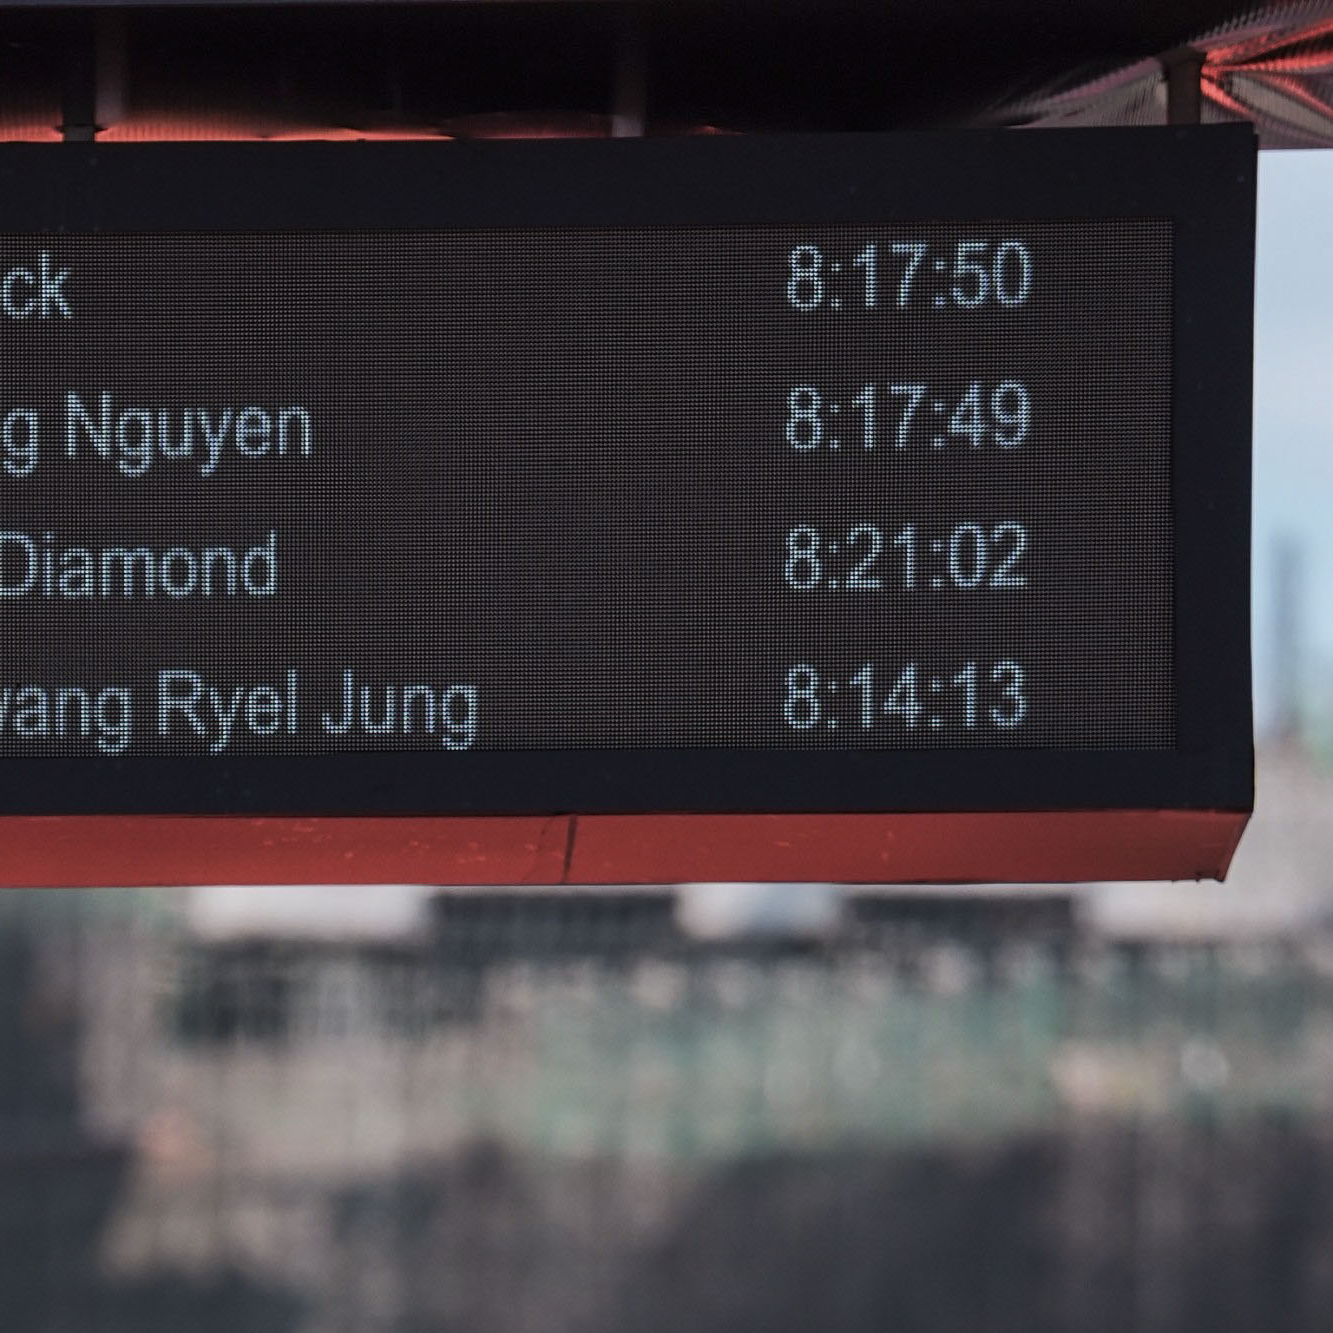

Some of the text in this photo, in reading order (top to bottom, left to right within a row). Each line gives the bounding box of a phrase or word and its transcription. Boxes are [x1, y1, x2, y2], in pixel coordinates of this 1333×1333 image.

[786, 240, 1032, 310] 8:17:50
[65, 391, 313, 477] Nguyen
[785, 380, 1032, 450] 8:17:49
[783, 521, 1029, 589] 8:21:02
[157, 669, 298, 751] Ryel
[322, 669, 479, 751] Jung
[783, 660, 1028, 729] 8:14:13
